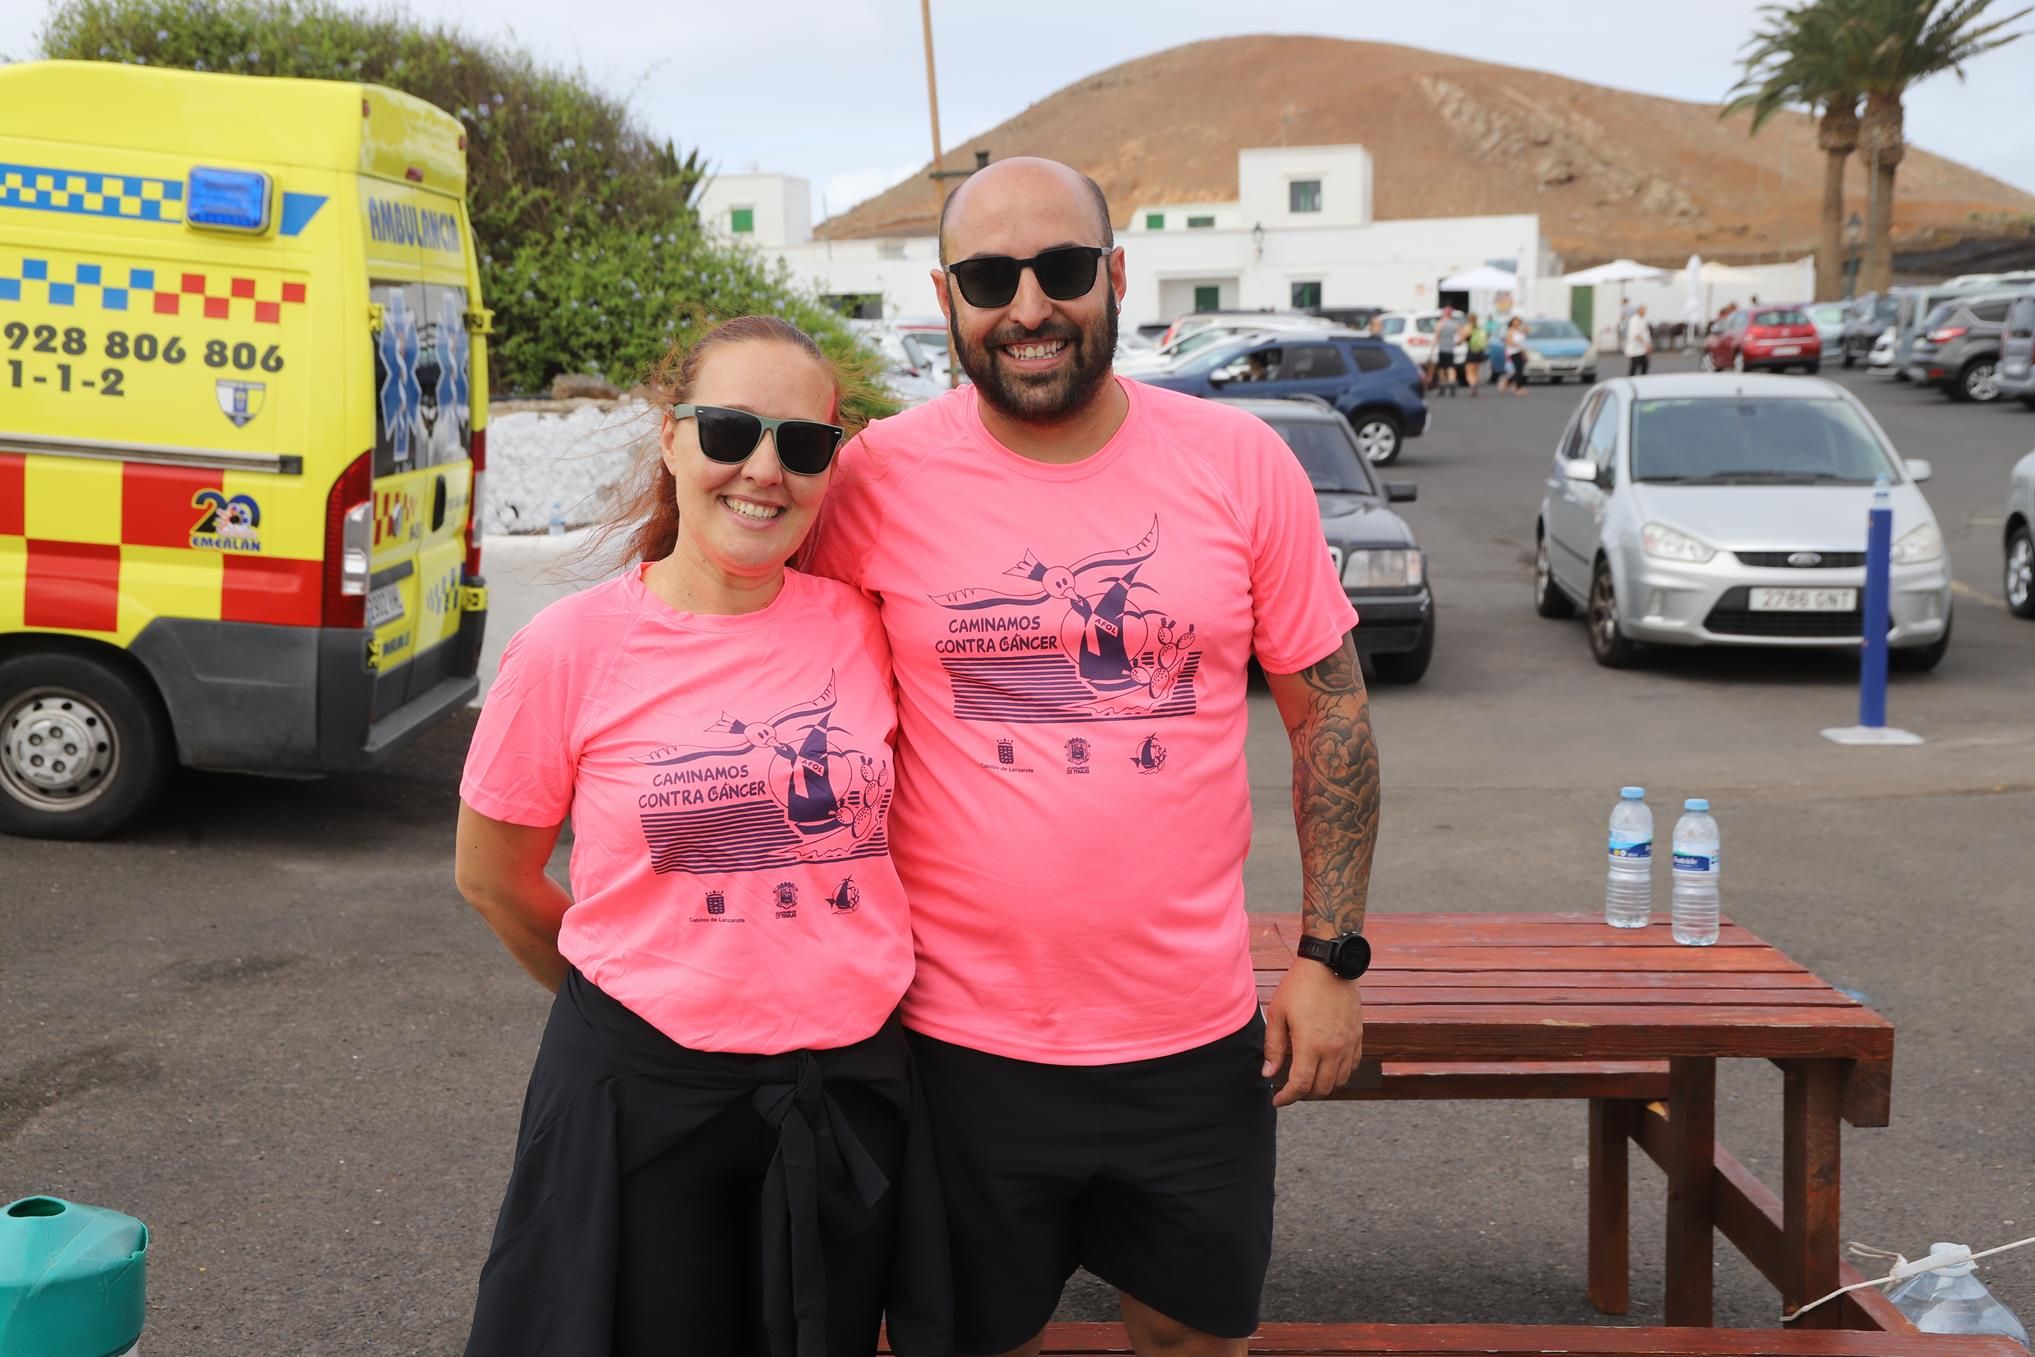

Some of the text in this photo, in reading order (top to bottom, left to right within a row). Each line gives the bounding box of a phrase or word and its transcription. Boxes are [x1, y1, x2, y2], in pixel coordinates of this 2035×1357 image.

[368, 195, 460, 252] AMBULANCIA
[4, 322, 284, 373] 928 806 806
[8, 359, 124, 397] 1-1-2
[948, 616, 1041, 633] CAMINAMOS
[1095, 618, 1117, 634] AFOL
[935, 638, 996, 653] CONTRA
[653, 764, 749, 787] CAMINAMOS
[638, 789, 704, 808] CONTRA
